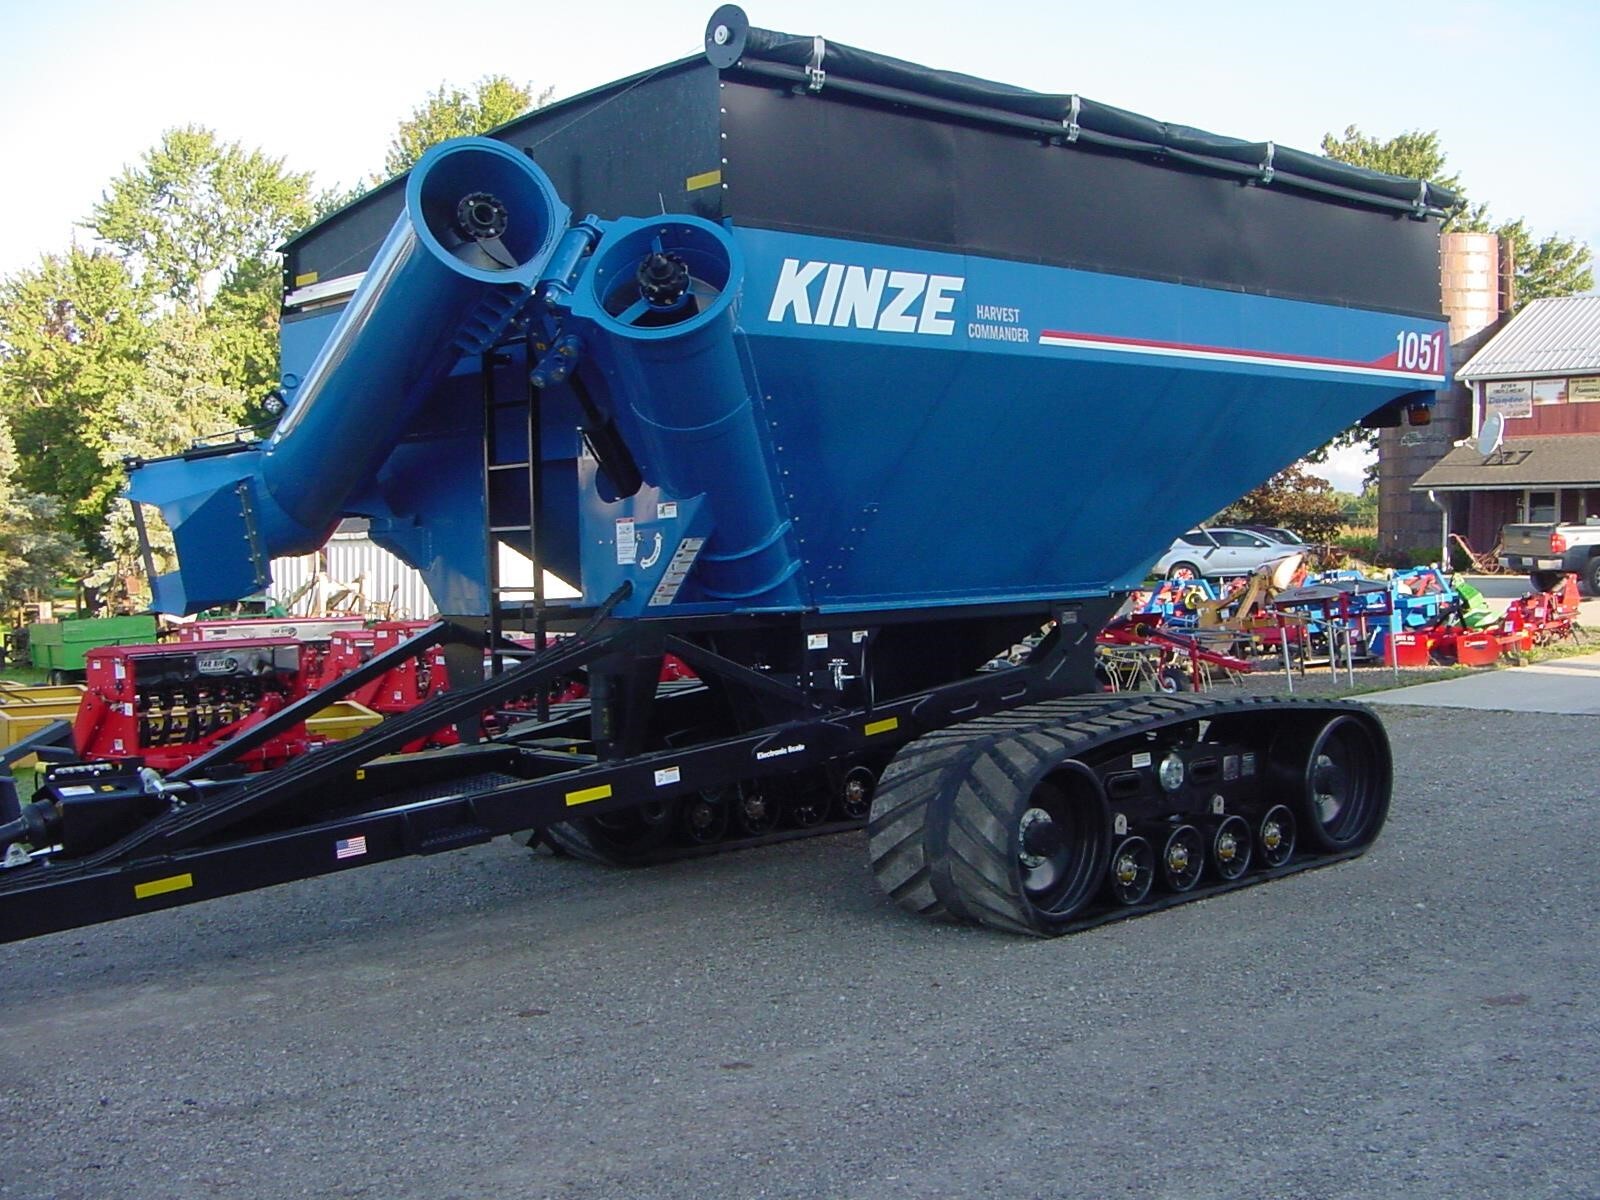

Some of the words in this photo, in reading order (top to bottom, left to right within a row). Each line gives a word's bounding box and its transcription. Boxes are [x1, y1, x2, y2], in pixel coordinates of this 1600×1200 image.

[767, 258, 965, 336] KINZE
[976, 304, 1020, 323] HARVEST
[967, 323, 1029, 343] COMMANDER
[1396, 330, 1441, 372] 1051
